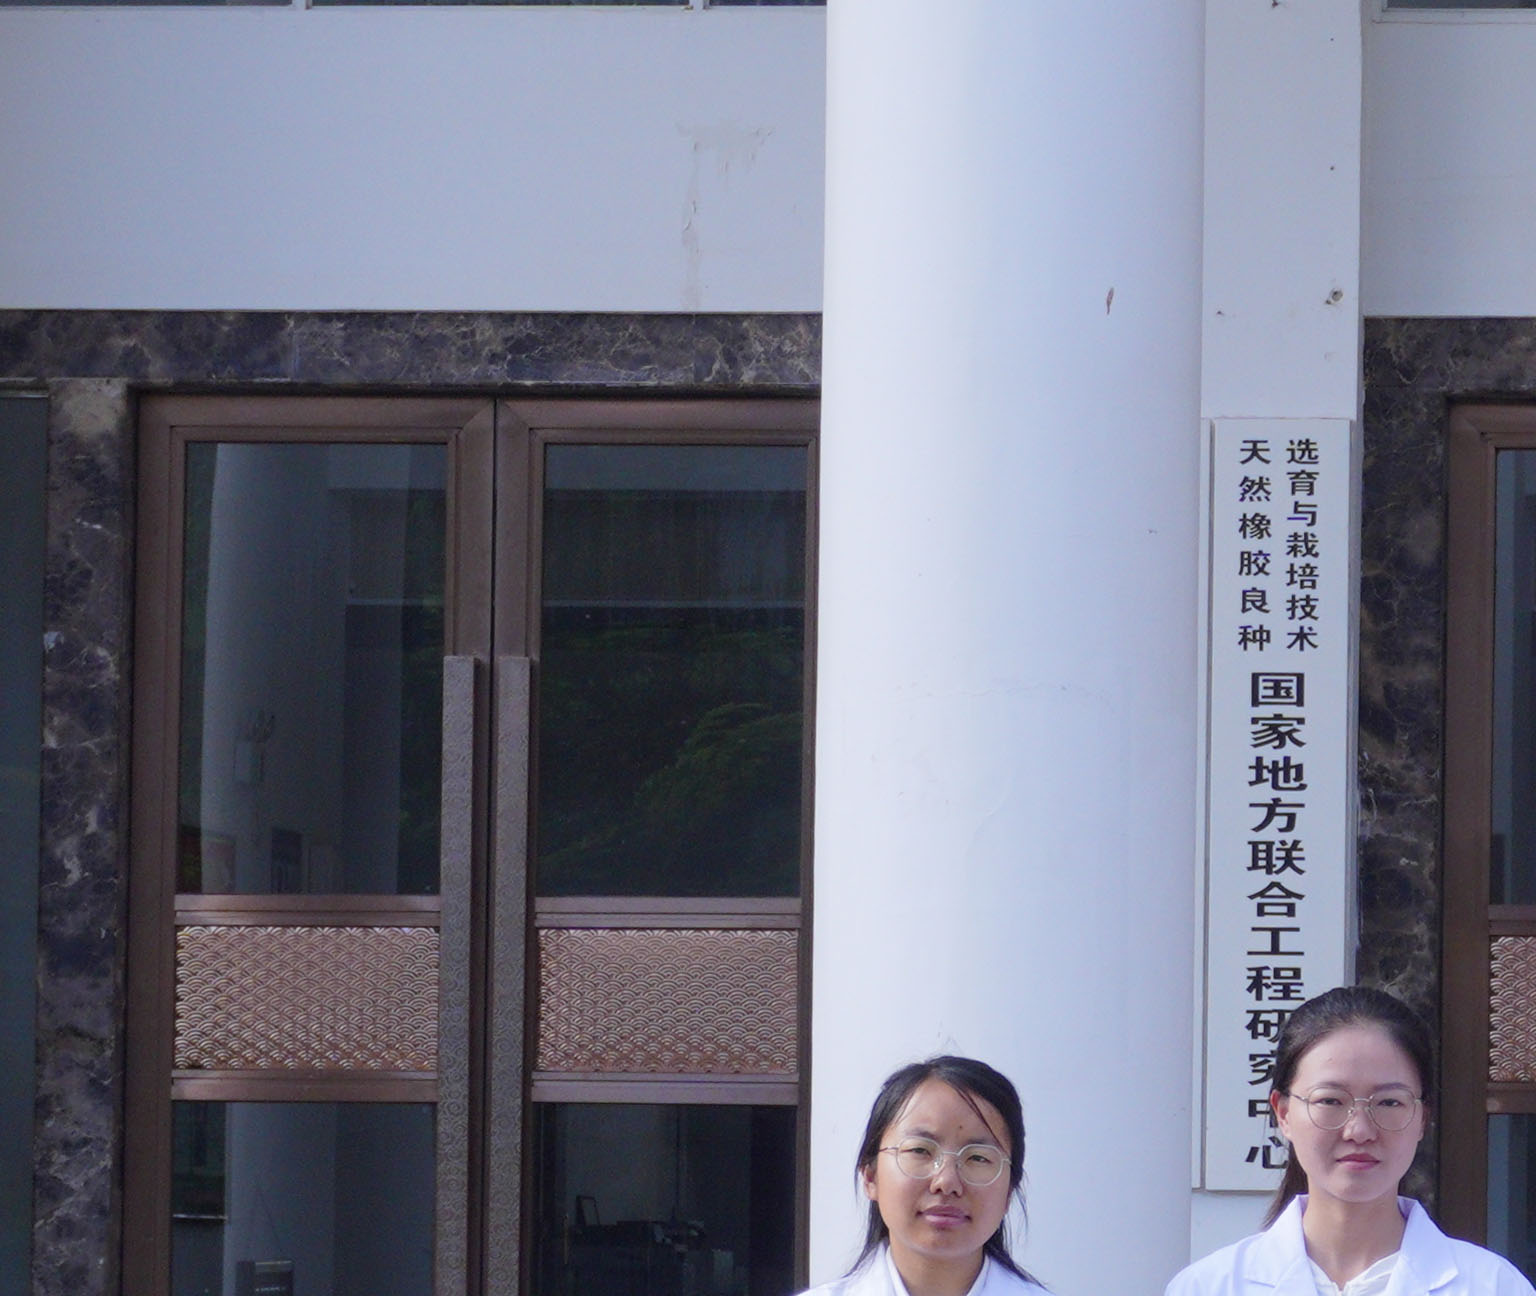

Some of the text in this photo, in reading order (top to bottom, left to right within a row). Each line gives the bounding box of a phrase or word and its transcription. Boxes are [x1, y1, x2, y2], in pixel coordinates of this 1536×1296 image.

[1237, 438, 1273, 652] 天然橡胶良种
[1284, 437, 1321, 652] 选育与栽培技术
